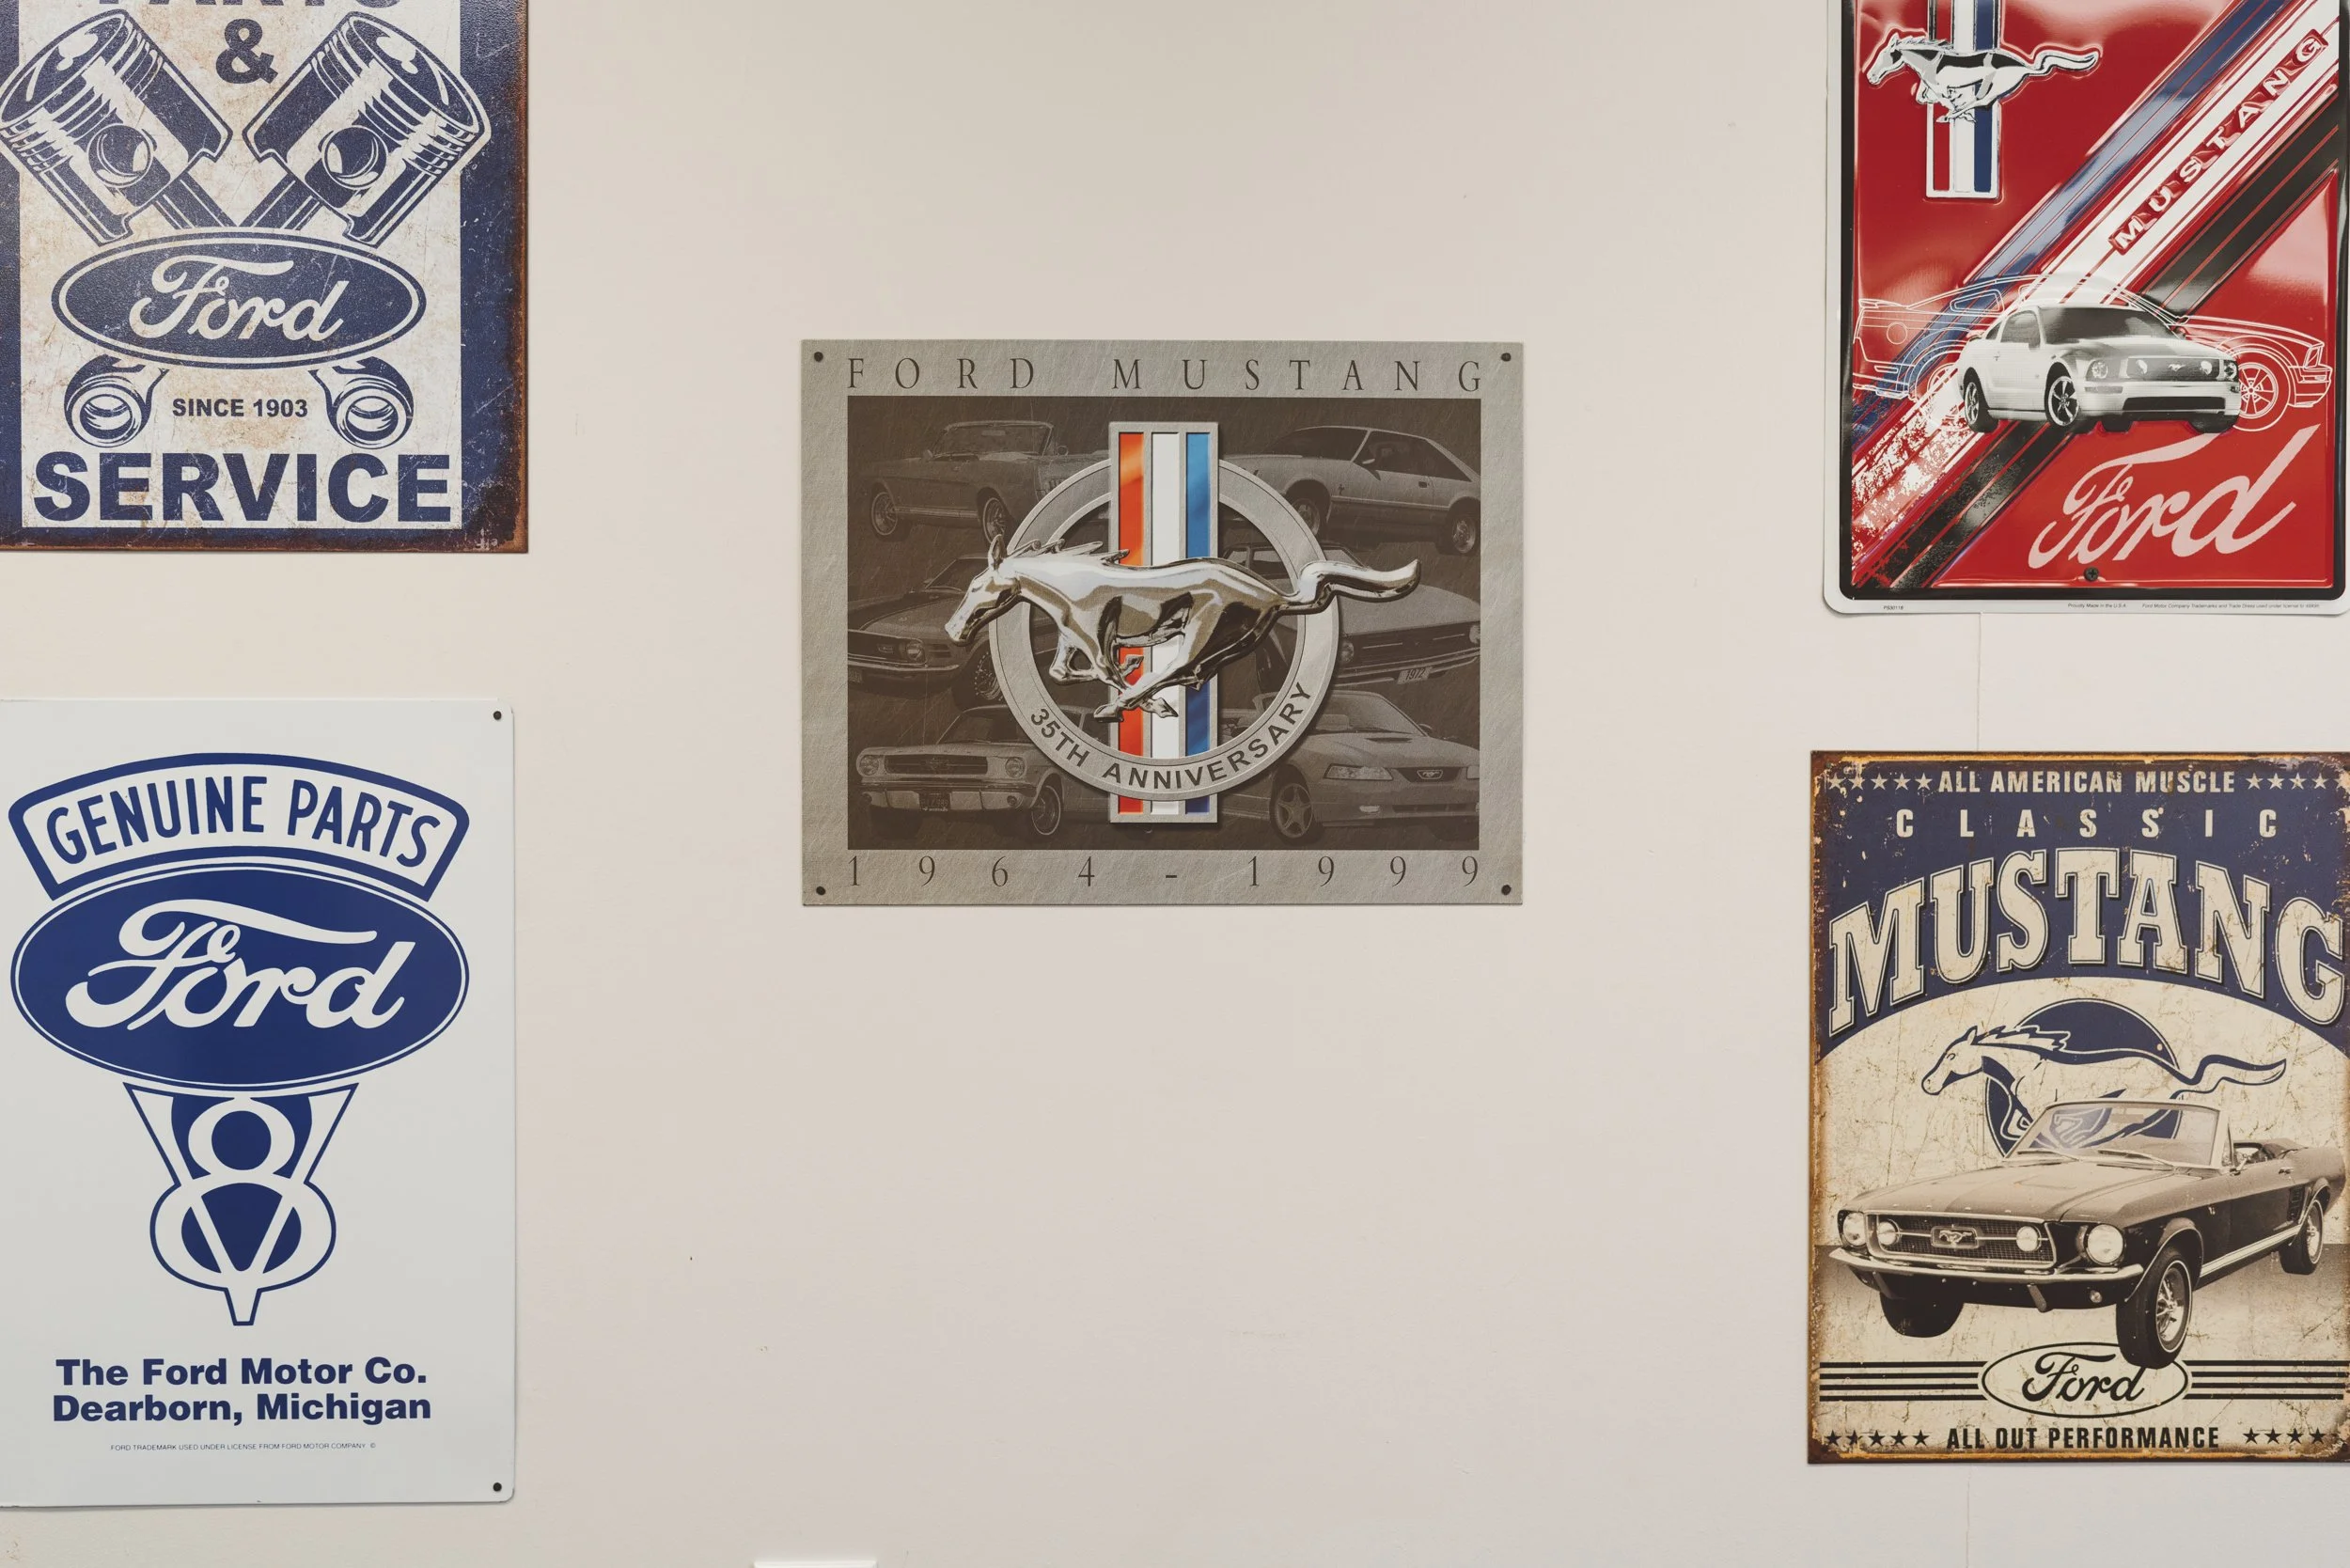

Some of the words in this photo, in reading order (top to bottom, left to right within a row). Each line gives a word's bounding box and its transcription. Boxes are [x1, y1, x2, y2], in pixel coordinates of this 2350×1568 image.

[215, 18, 279, 85] &
[2114, 36, 2323, 250] MUSTANG
[130, 255, 350, 342] Ford
[847, 357, 1035, 391] FORD
[1111, 358, 1482, 393] MUSTANG
[172, 398, 244, 417] SINCE
[253, 398, 308, 417] 1903
[33, 451, 451, 523] SERVICE
[2028, 424, 2321, 569] Ford
[1030, 707, 1091, 768] 35TH
[1101, 681, 1312, 790] ANNIVERSARY
[1938, 770, 1981, 793] ALL
[1990, 770, 2123, 793] AMERICAN
[2135, 770, 2236, 793] MUSCLE
[45, 776, 268, 865] GENUINE
[287, 779, 441, 869] PARTS
[1895, 808, 2278, 839] CLASSIC
[848, 855, 1481, 886] 1964-1999
[65, 898, 416, 1031] Ford
[1828, 847, 2345, 1038] MUSTANG
[55, 1358, 129, 1387] The
[142, 1358, 227, 1387] Ford
[241, 1357, 353, 1386] Motor
[364, 1356, 428, 1385] Co.
[2022, 1351, 2146, 1403] Ford
[53, 1394, 243, 1427] Dearborn,
[257, 1392, 431, 1426] Michigan
[1946, 1427, 1985, 1450] ALL
[1995, 1427, 2040, 1450] OUT
[2048, 1426, 2219, 1450] PERFORMANCE
